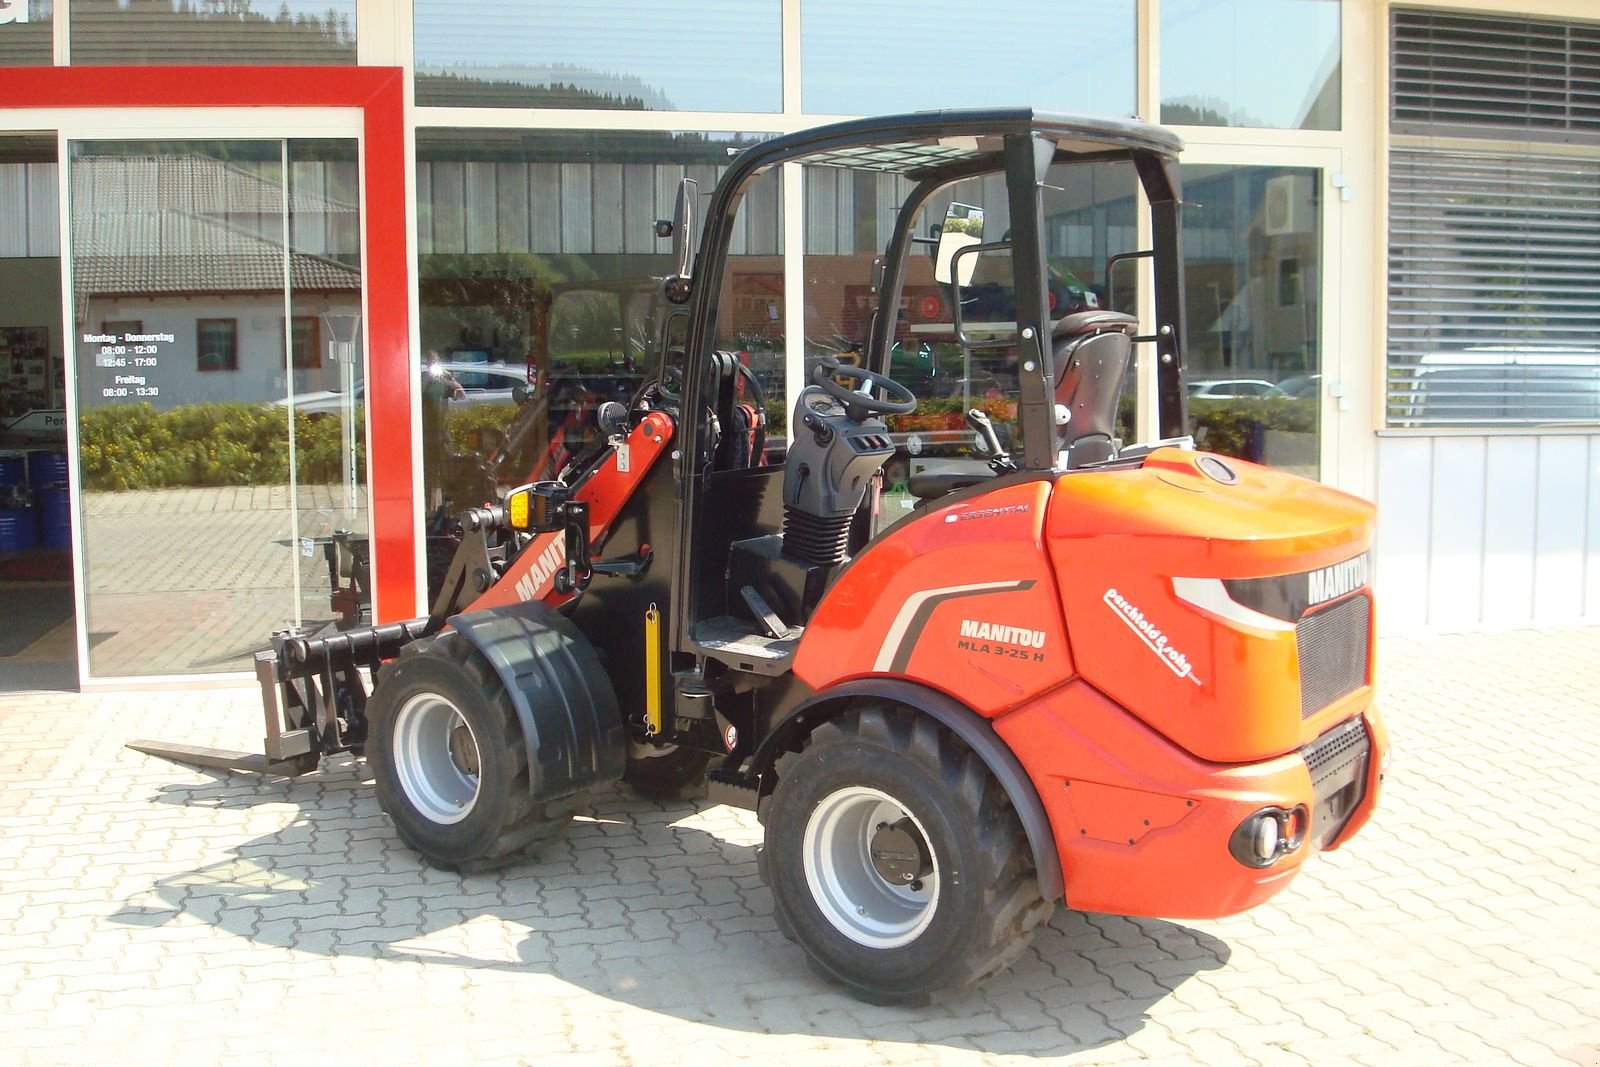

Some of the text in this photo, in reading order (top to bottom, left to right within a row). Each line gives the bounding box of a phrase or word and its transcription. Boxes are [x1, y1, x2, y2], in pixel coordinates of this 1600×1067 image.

[83, 334, 116, 344] Montag
[125, 333, 174, 343] Donnerstag
[101, 346, 126, 355] 08:00
[134, 345, 157, 354] 12:00
[103, 358, 126, 367] 12:45
[134, 358, 157, 366] 17:00
[115, 375, 146, 385] Freitag
[103, 388, 128, 397] 08:00
[135, 387, 159, 396] 13:30
[1308, 552, 1368, 605] MANITOU
[960, 619, 1046, 649] MANITOU
[957, 640, 1045, 662] MLA 3-25 H
